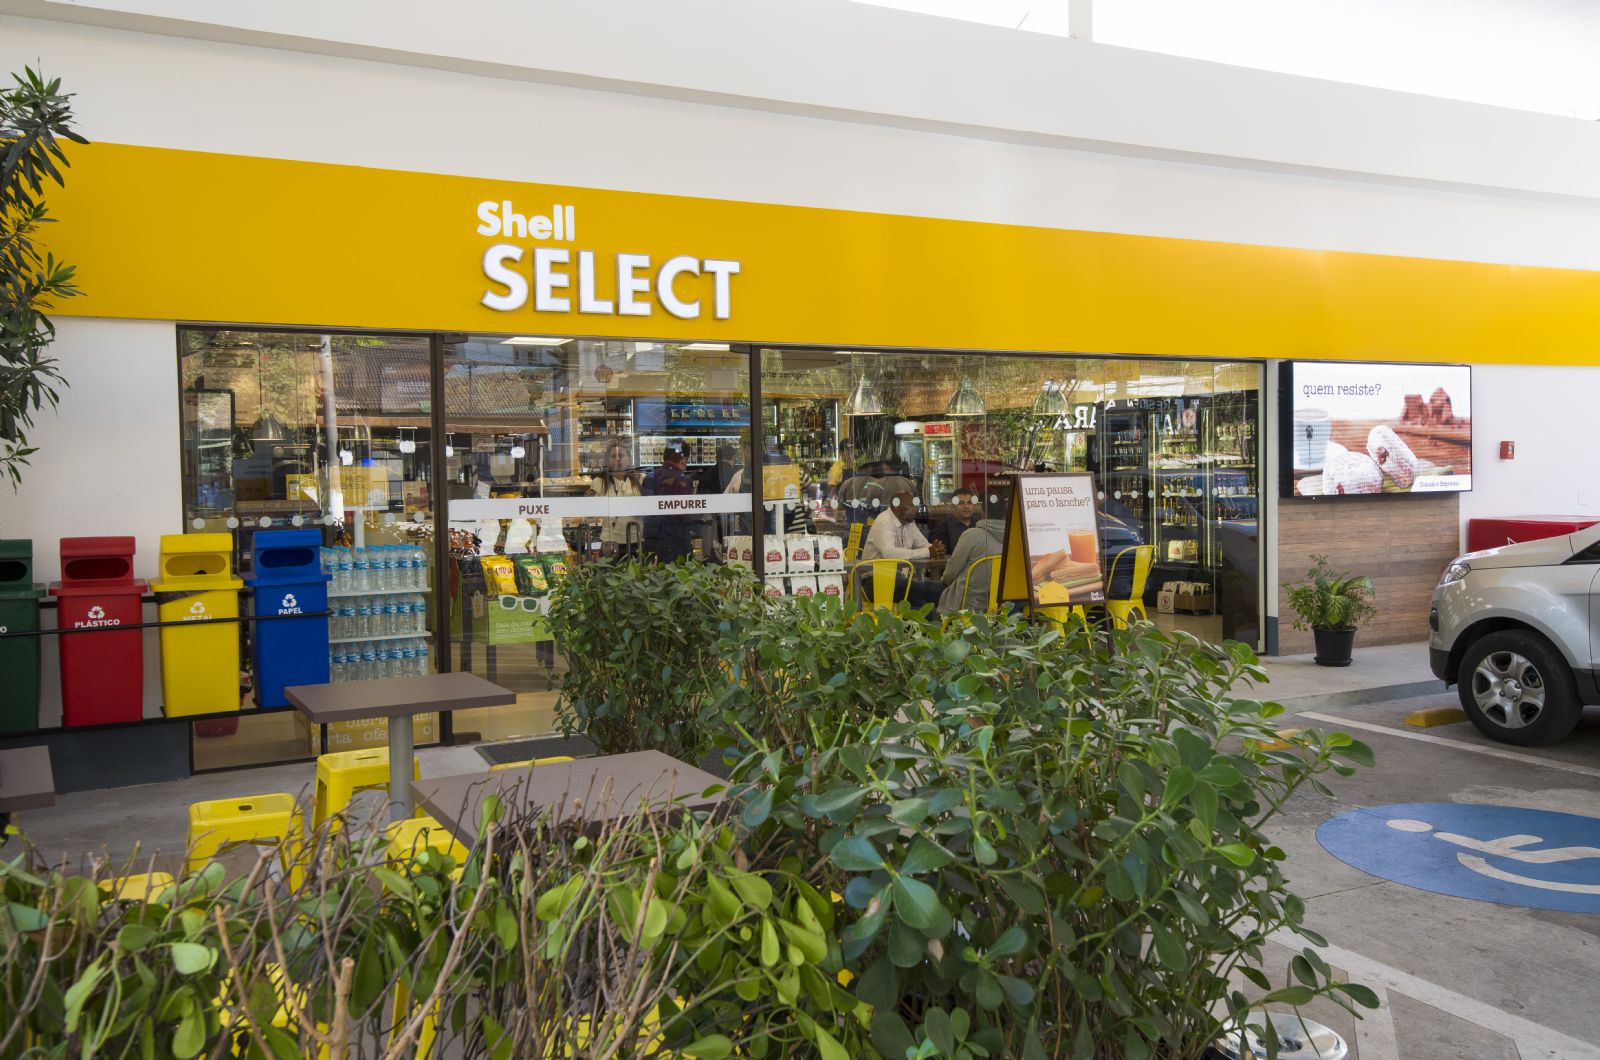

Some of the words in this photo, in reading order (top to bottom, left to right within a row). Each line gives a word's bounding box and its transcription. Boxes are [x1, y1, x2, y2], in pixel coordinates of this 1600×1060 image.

[477, 200, 575, 241] Shell
[481, 243, 741, 320] SELECT
[1302, 383, 1334, 398] quem
[1337, 383, 1382, 396] resiste?
[1024, 487, 1046, 496] uma
[1046, 486, 1074, 497] pausa
[518, 504, 550, 515] PUXE
[658, 499, 707, 510] EMPURRE
[1026, 499, 1048, 510] para
[1049, 499, 1055, 508] o
[1056, 496, 1091, 508] lanche?
[278, 607, 303, 615] PAPEL
[74, 618, 121, 629] PLÁSTICO
